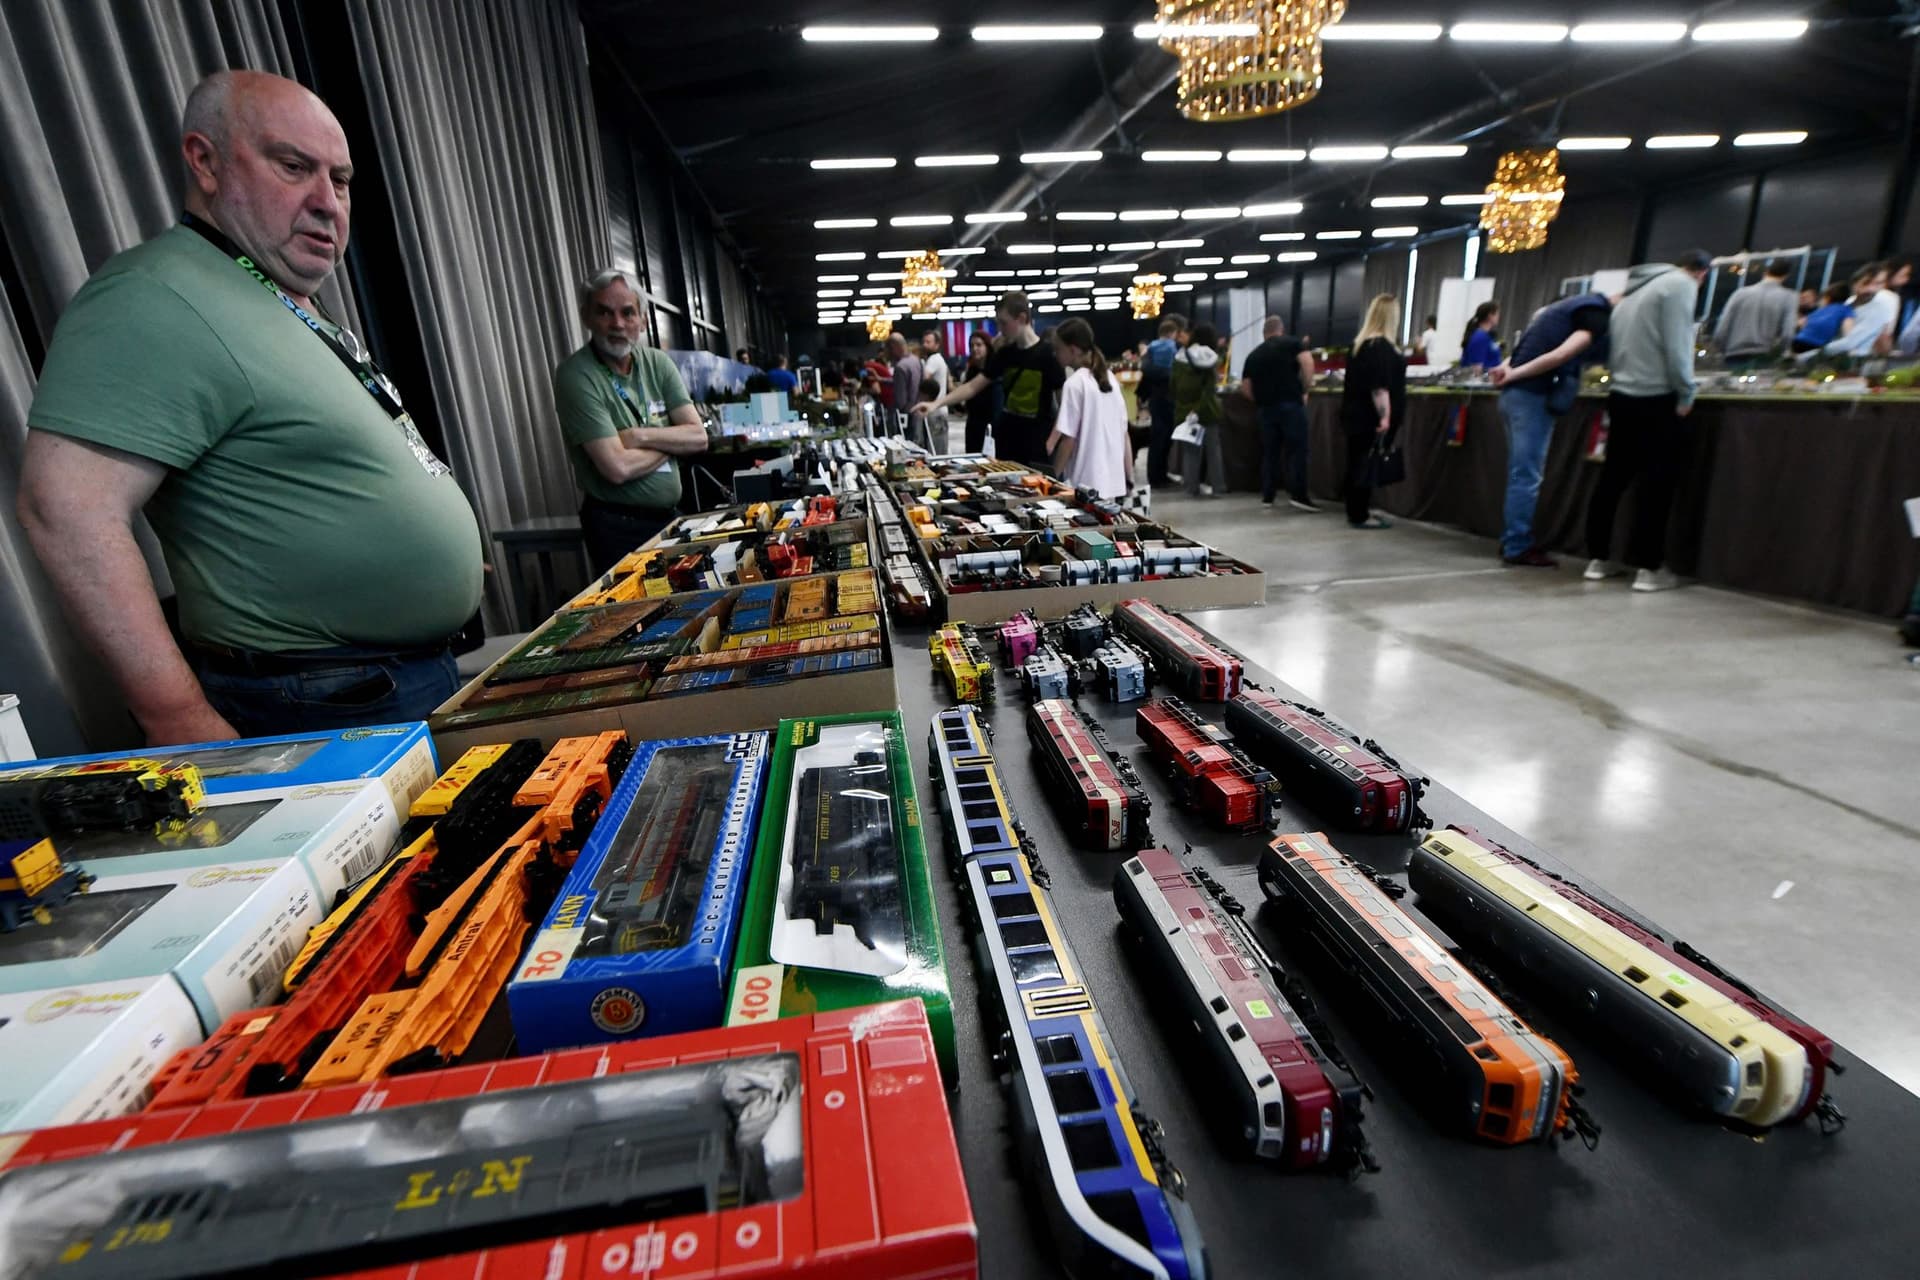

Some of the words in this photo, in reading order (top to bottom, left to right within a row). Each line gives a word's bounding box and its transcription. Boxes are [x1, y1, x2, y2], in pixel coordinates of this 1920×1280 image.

[729, 733, 753, 760] DCC
[701, 831, 739, 945] DCC-EQUIPPED
[730, 759, 755, 823] LOCOMOTIVE
[447, 920, 485, 961] Amtrak
[523, 949, 564, 979] 70
[591, 987, 643, 1014] BACHMANN
[739, 976, 773, 1020] 100
